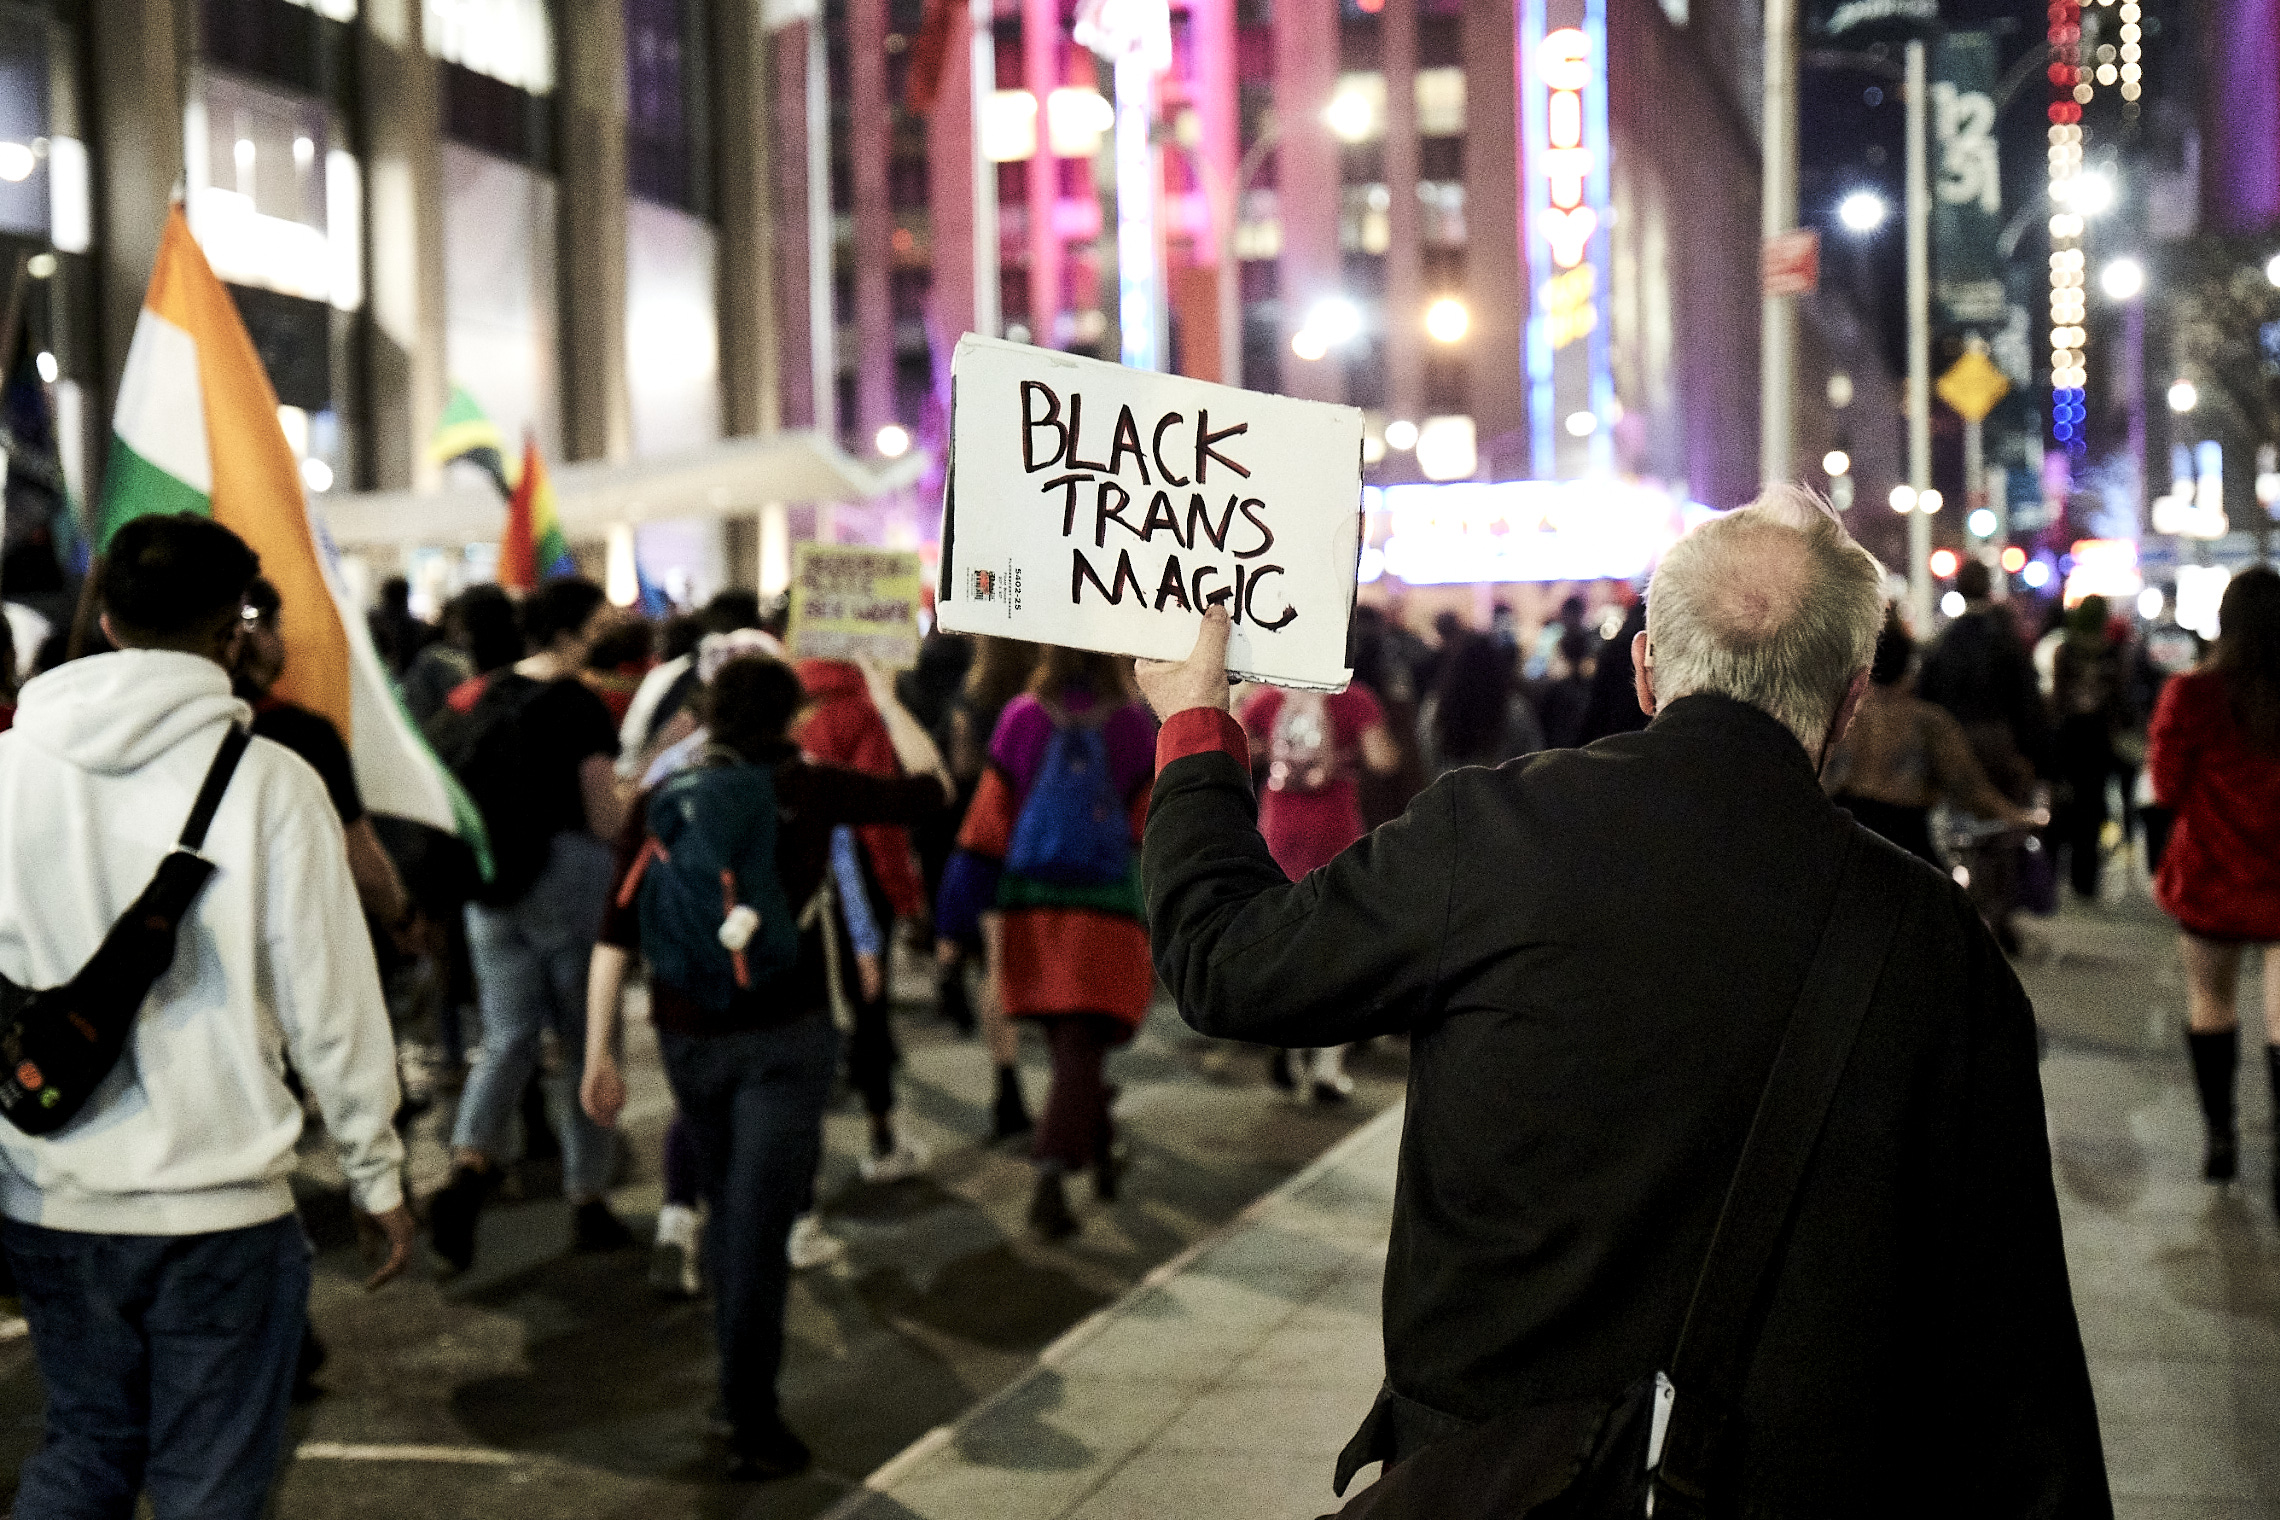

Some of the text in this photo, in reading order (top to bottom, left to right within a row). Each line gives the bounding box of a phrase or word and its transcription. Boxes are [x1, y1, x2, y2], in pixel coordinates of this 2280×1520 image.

[1020, 380, 1252, 487] BLACK
[1041, 473, 1275, 560] TRANS
[1014, 568, 1022, 611] 5402-25
[1071, 548, 1299, 632] MAGIC
